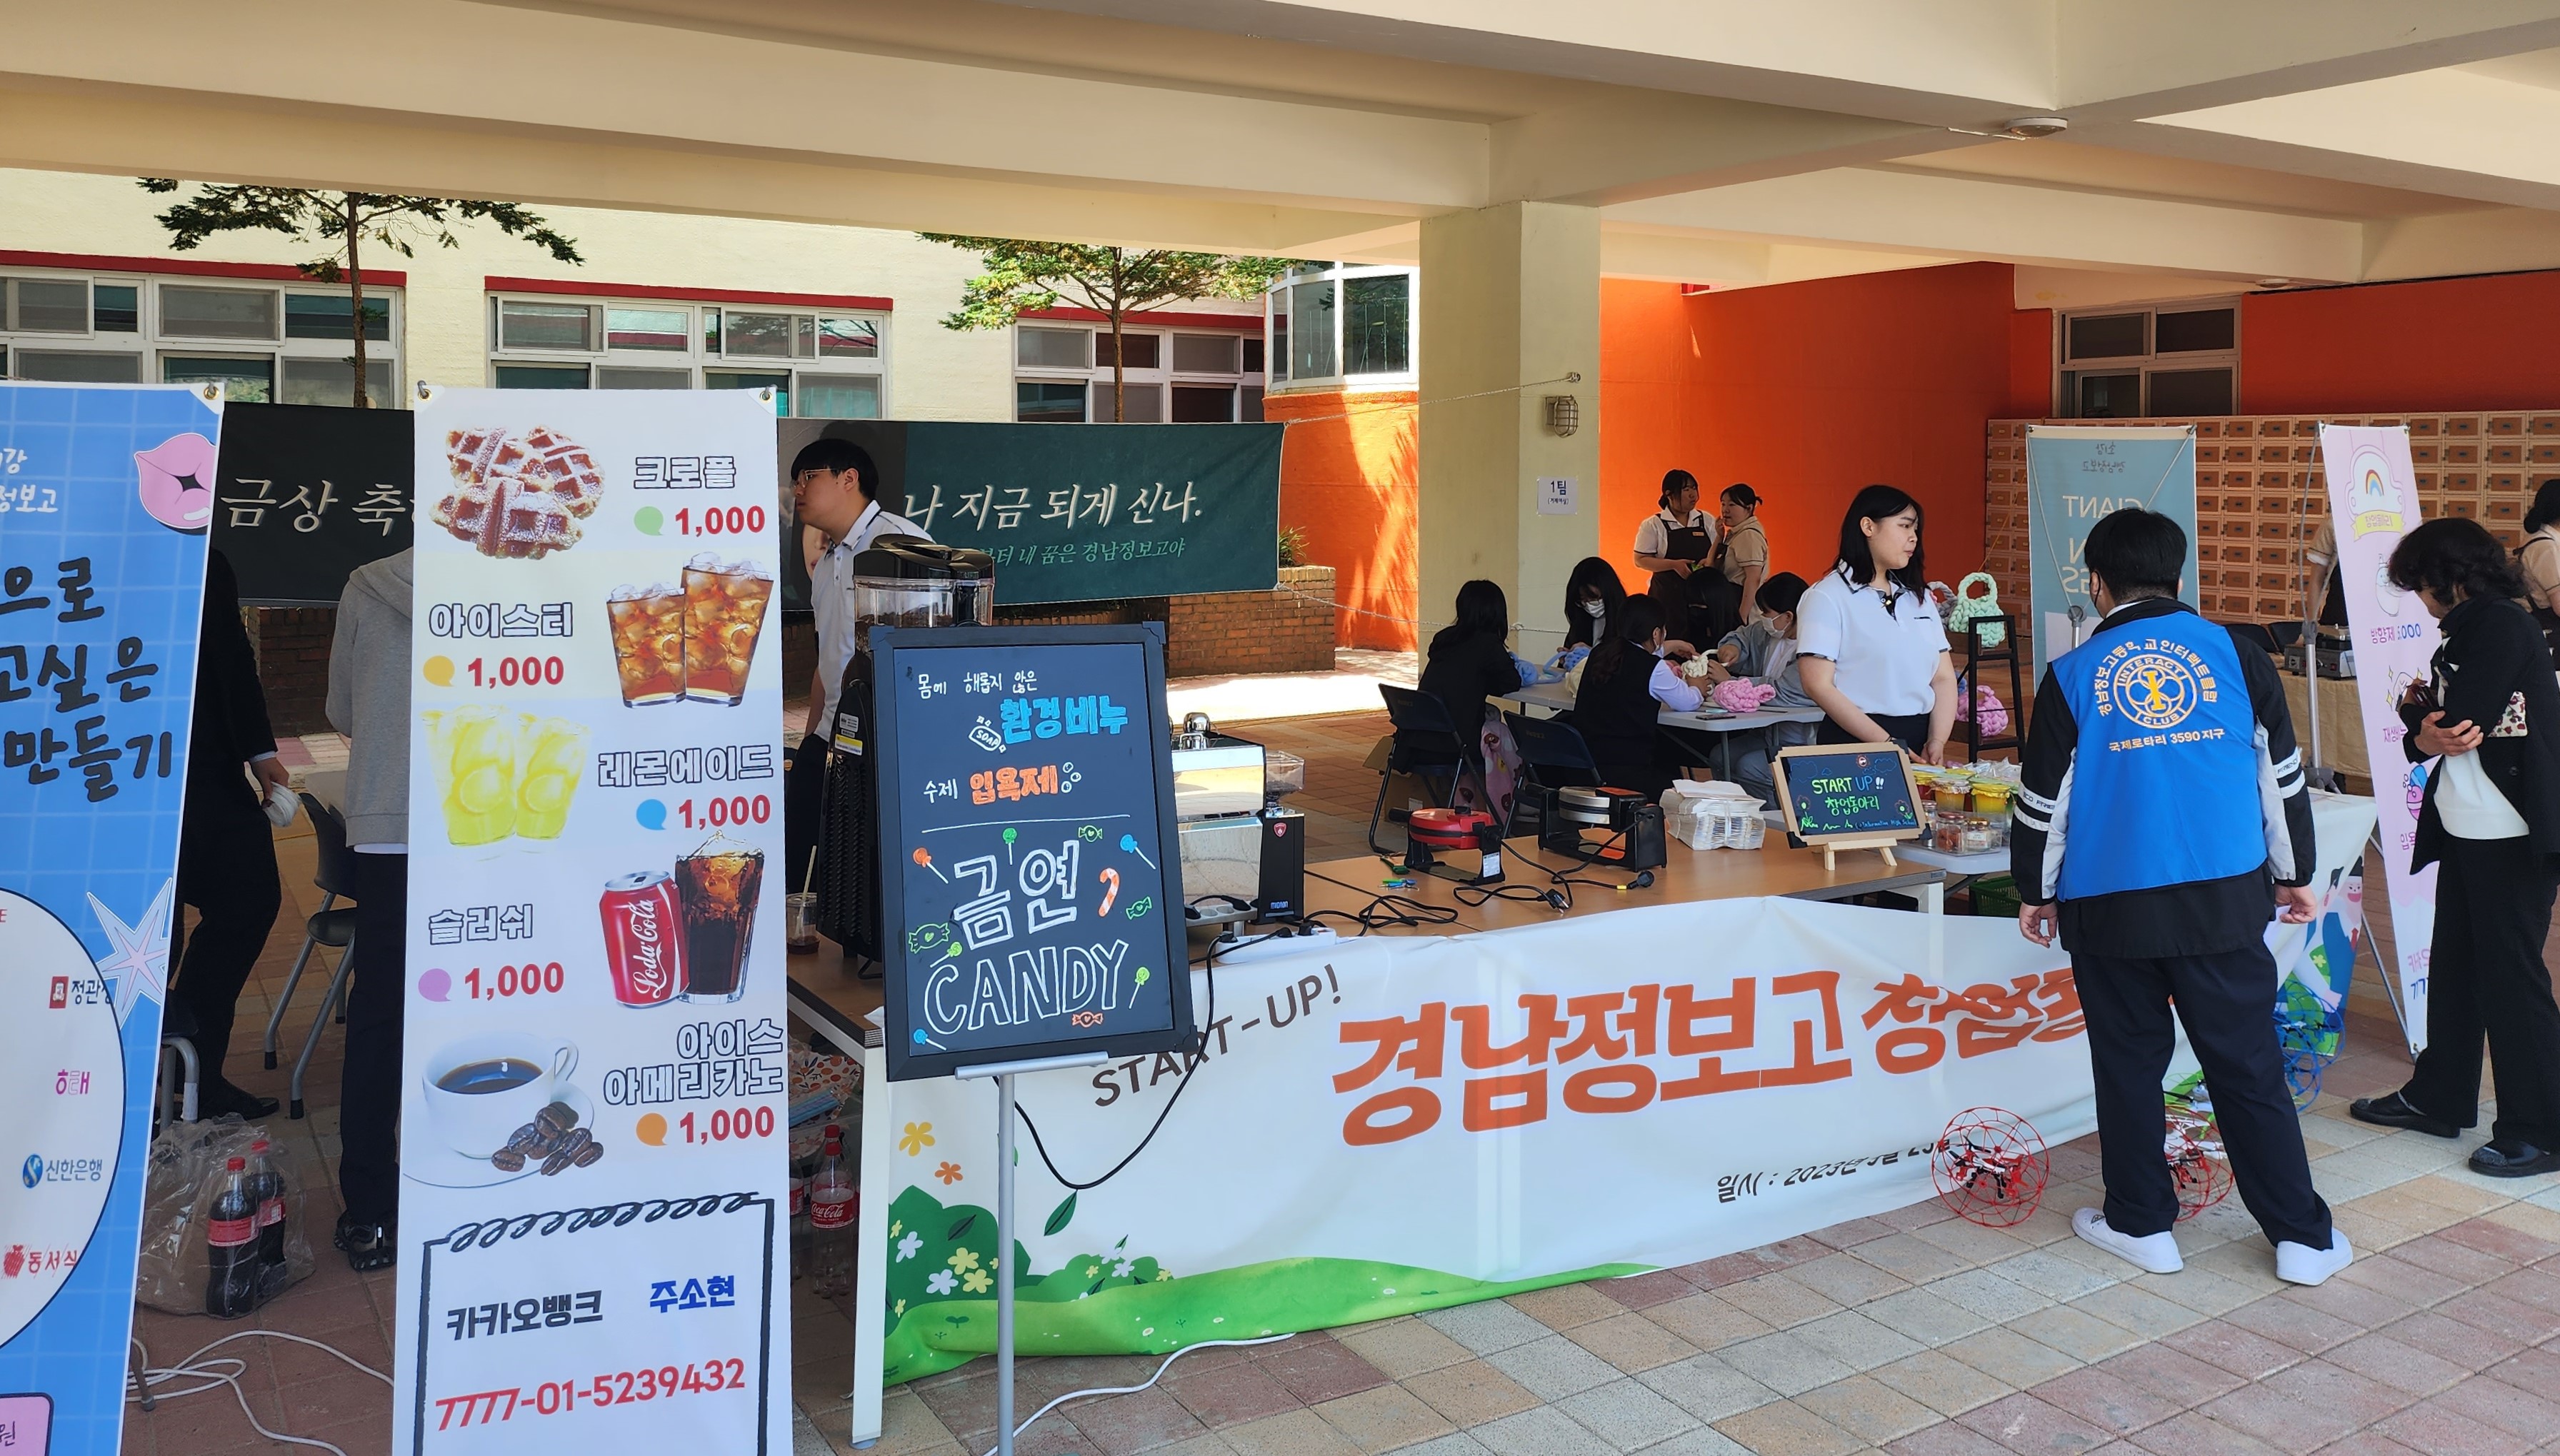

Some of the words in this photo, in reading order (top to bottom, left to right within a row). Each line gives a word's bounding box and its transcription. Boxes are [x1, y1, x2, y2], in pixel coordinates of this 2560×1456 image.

[633, 456, 736, 489] 크로플
[1551, 481, 1566, 496] 1팀
[220, 477, 338, 533] 금상
[351, 483, 414, 536] 축
[674, 505, 766, 537] 1,000
[952, 486, 1032, 531] 지금
[1040, 483, 1117, 529] 되게
[1125, 481, 1204, 524] 신나.
[1019, 547, 1041, 566] 내
[1041, 543, 1076, 566] 꿈은
[1081, 537, 1186, 562] 경남정보고야
[429, 602, 574, 638] 아이스티
[467, 656, 564, 688] 1,000
[918, 673, 947, 699] 몸에
[964, 671, 1003, 693] 해롭지
[1012, 669, 1038, 695] 않은
[2118, 657, 2184, 682] INTERACT
[1000, 694, 1129, 744] 환경비누
[2143, 713, 2180, 726] CLUB
[975, 729, 999, 748] SOAP
[2109, 734, 2167, 752] 국제로타리
[4, 715, 172, 803] 만들기
[598, 744, 774, 788] 레몬에이드
[924, 779, 959, 803] 수제
[969, 764, 1059, 805] 입욕제
[1811, 777, 1852, 795] START
[678, 794, 771, 830] 1,000
[1825, 795, 1880, 816] 창업동아리
[954, 840, 1079, 950] 금연
[429, 903, 533, 945] 슬러쉬
[464, 962, 564, 1000] 1,000
[924, 938, 1129, 1035] CANDY
[676, 1019, 784, 1060] 아이스
[1331, 970, 1853, 1146] 경남정보고
[604, 1058, 784, 1106] 아메리카노
[679, 1106, 775, 1145] 1,000
[46, 1159, 102, 1182] 신한은행
[1717, 1171, 1764, 1204] 일시
[447, 1290, 603, 1341] 카카오뱅크
[649, 1275, 735, 1314] 주소현
[435, 1357, 746, 1432] 7777-01-5239432
